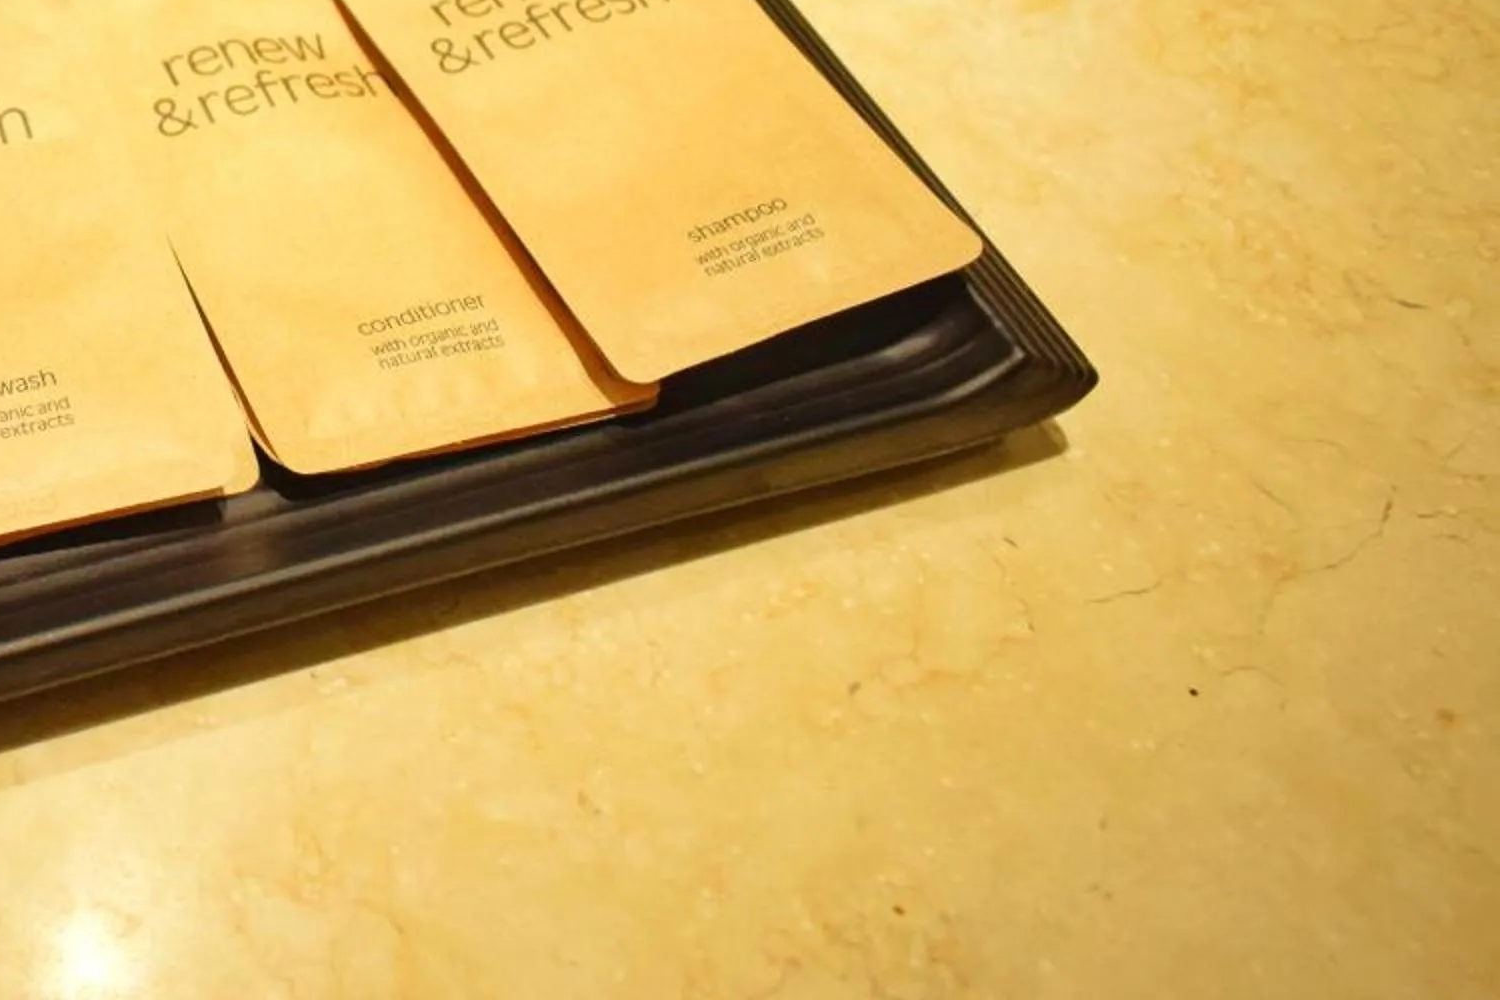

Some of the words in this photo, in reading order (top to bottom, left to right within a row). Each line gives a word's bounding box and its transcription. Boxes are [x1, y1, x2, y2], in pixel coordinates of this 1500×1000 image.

[161, 33, 326, 87] renew
[687, 197, 788, 243] shampoo
[696, 245, 731, 265] with
[786, 213, 816, 233] and
[703, 248, 761, 277] natural
[357, 294, 485, 337] conditioner
[371, 338, 407, 356] with
[408, 325, 468, 348] organic
[469, 317, 500, 337] and
[378, 346, 438, 370] natural
[440, 334, 506, 358] extracts
[37, 396, 71, 415] and
[0, 412, 76, 440] extracts
